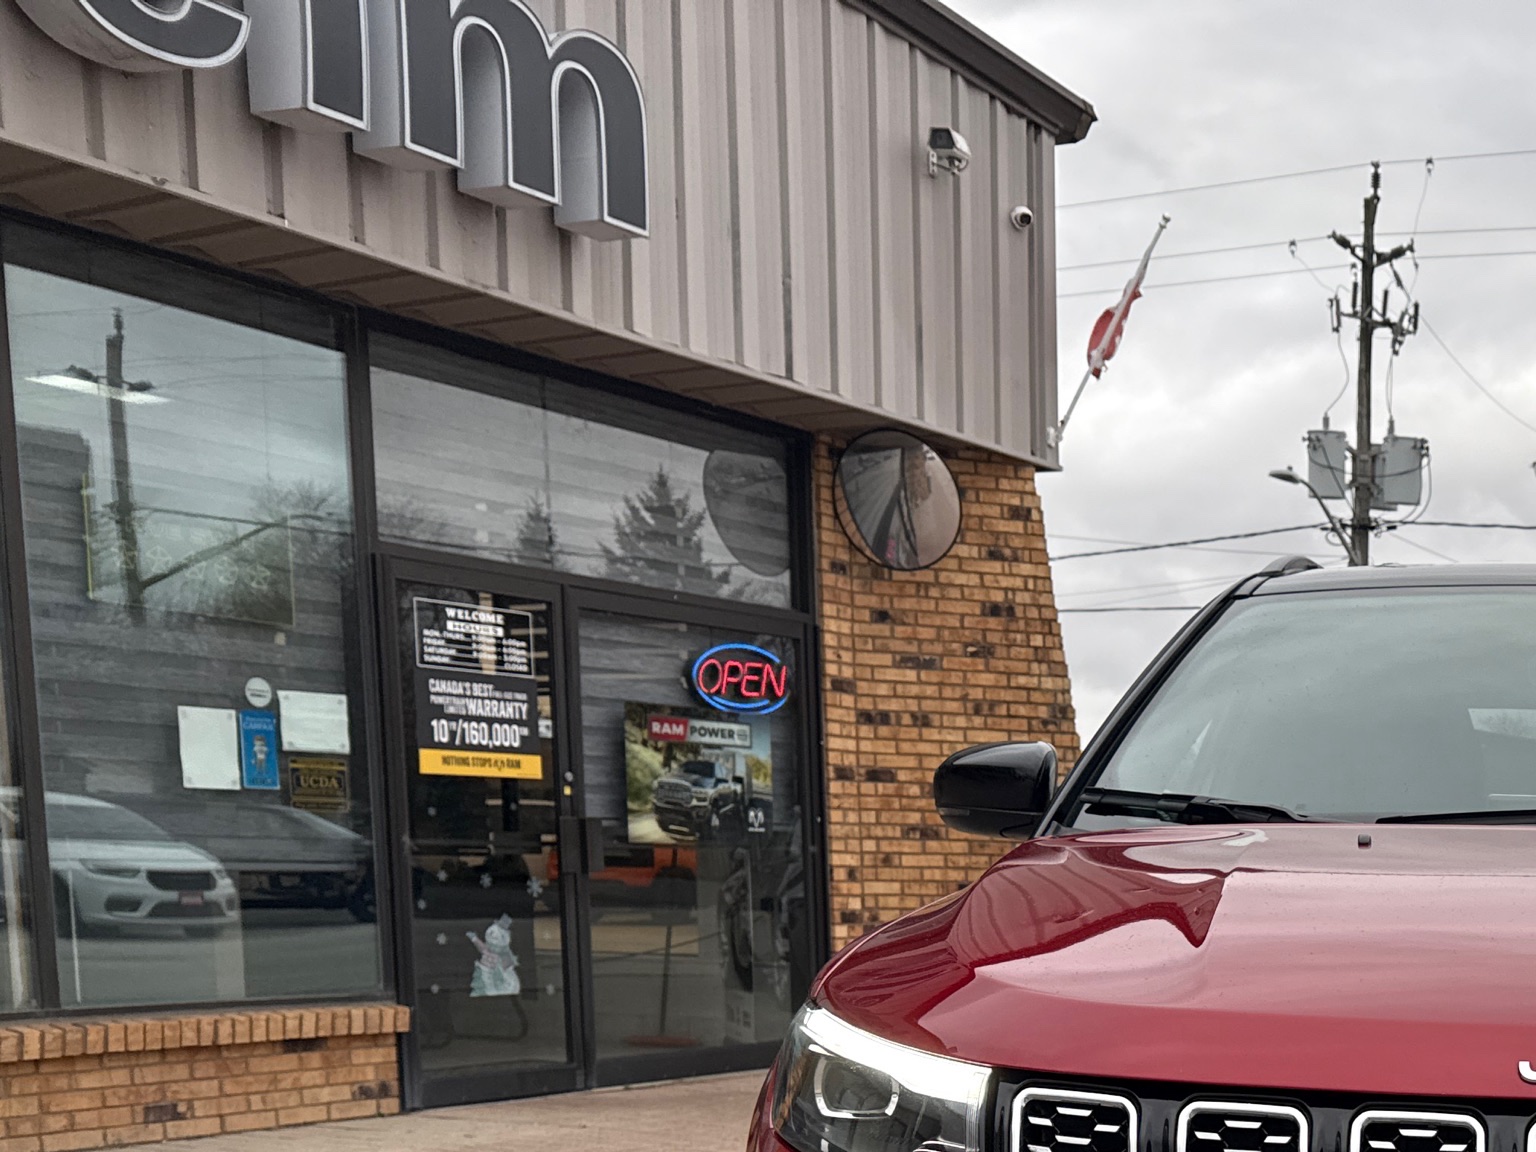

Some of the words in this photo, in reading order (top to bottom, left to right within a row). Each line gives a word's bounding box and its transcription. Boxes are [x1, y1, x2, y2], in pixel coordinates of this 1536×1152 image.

[445, 607, 504, 625] WELCOME
[452, 622, 499, 635] HOURS
[698, 657, 788, 698] OPEN
[429, 679, 471, 696] CANADA'S
[471, 682, 495, 699] BEST
[466, 698, 528, 720] WARRANTY
[651, 721, 684, 736] RAM
[690, 726, 736, 740] POWER
[300, 775, 339, 789] UCDA
